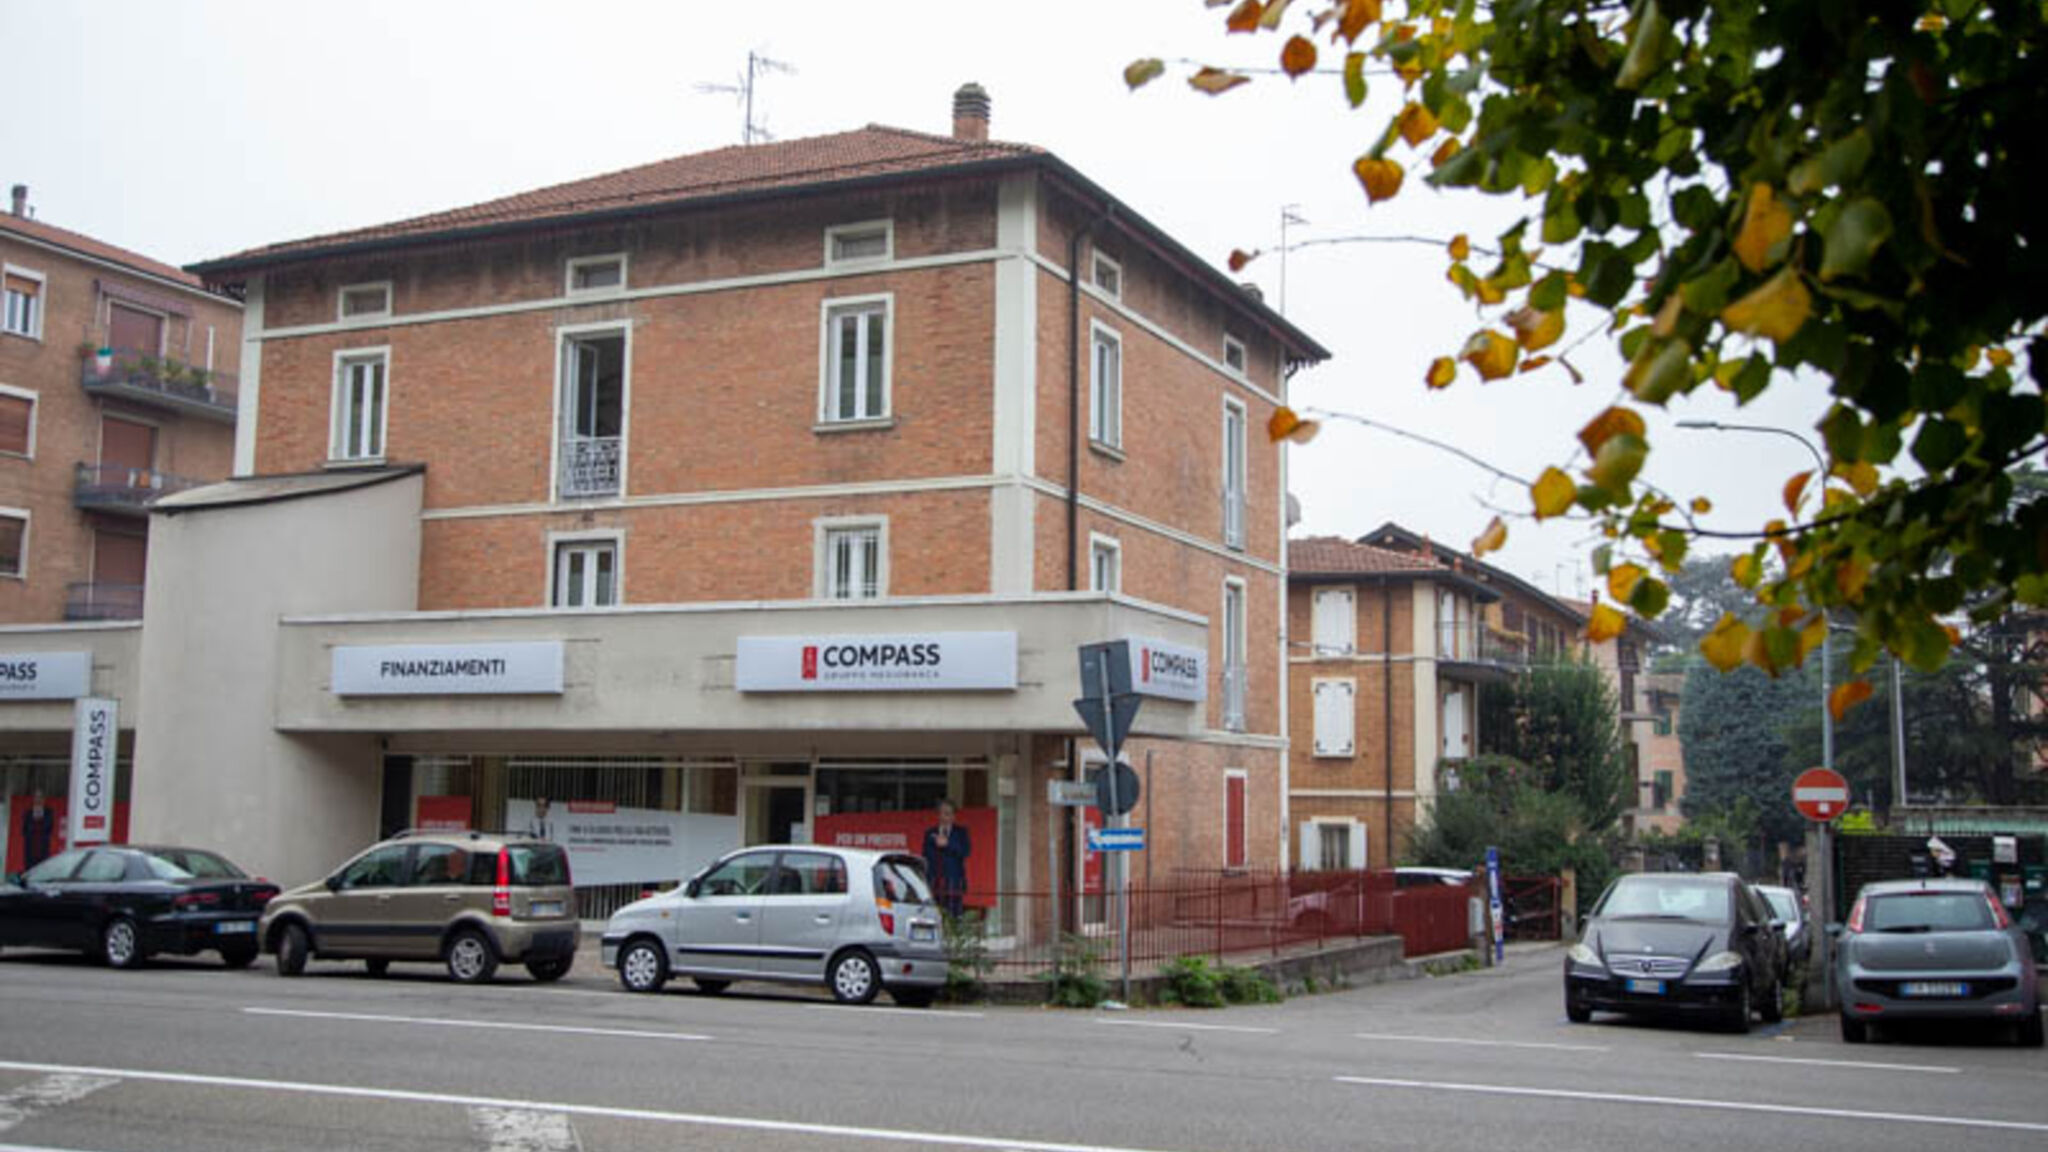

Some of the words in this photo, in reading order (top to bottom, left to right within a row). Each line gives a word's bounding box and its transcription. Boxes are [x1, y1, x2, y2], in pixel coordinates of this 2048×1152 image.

[380, 658, 506, 678] FINANZIAMENTI
[823, 644, 941, 667] COMPASS
[1152, 650, 1198, 679] COMPASS
[84, 709, 106, 811] COMPASS
